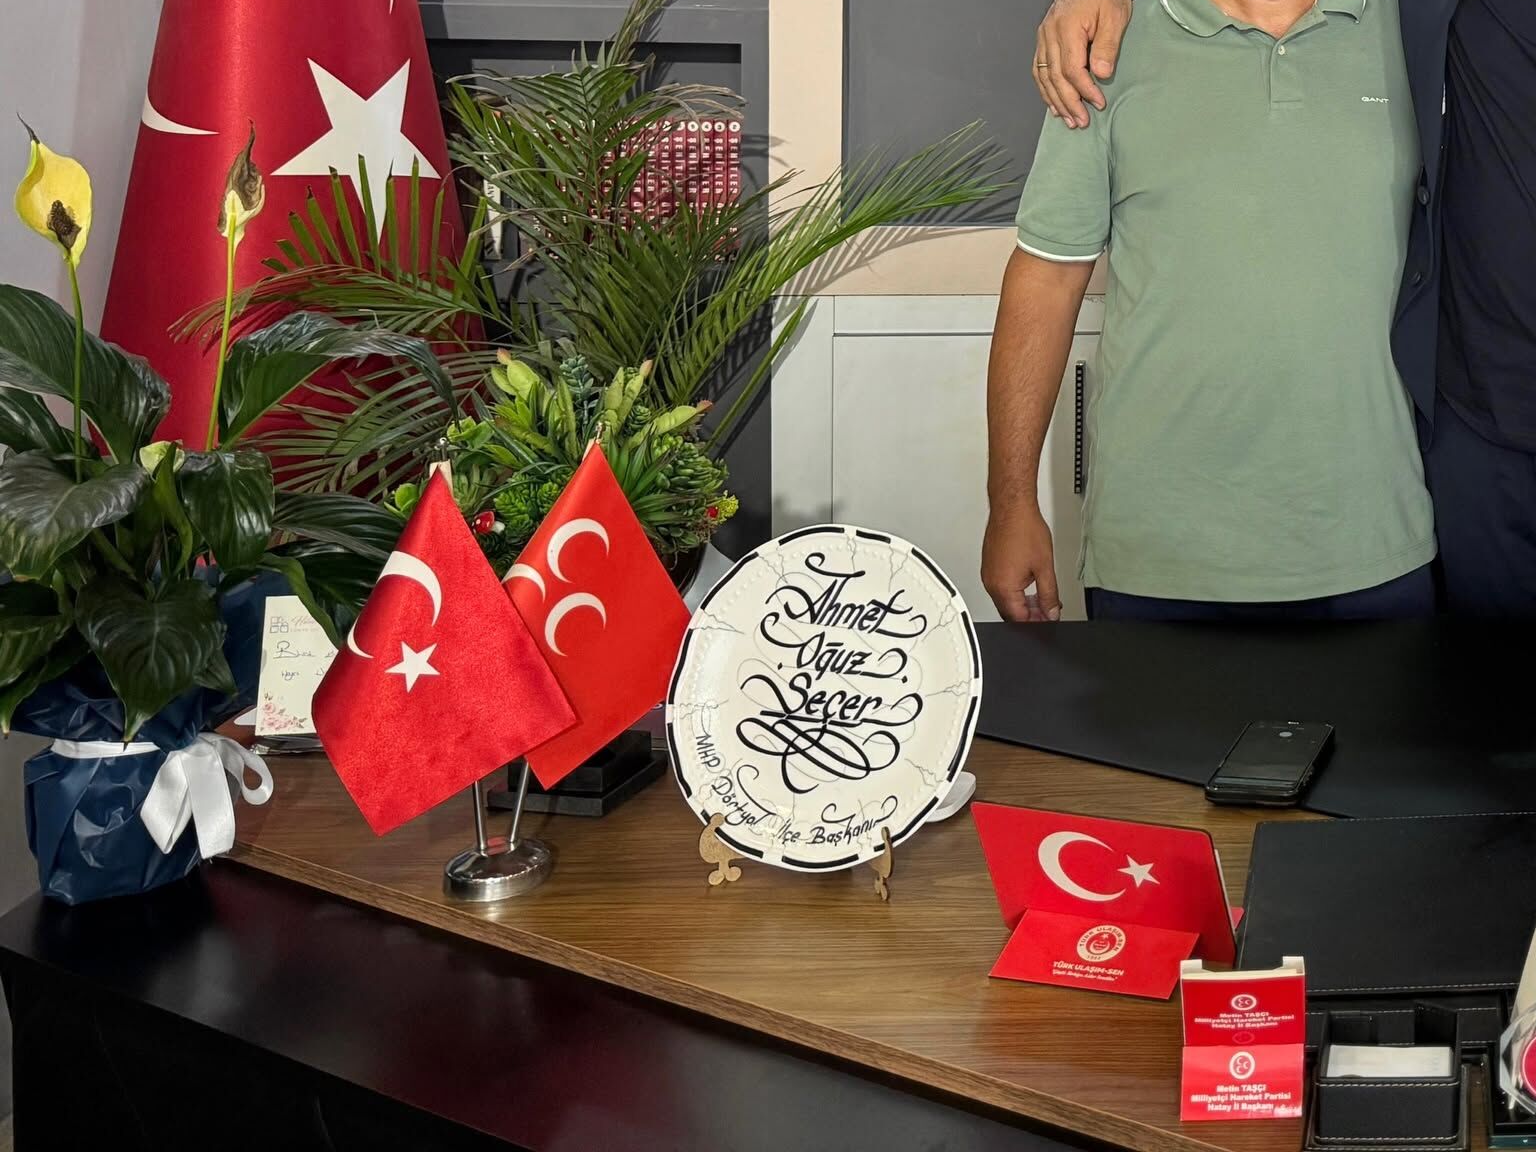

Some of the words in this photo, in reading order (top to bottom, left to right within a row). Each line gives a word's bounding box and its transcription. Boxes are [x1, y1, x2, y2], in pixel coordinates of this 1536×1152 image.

[765, 552, 926, 638] Ahmet
[740, 673, 923, 728] Seçer
[695, 734, 721, 768] MHP
[711, 765, 776, 826] Dörtyol
